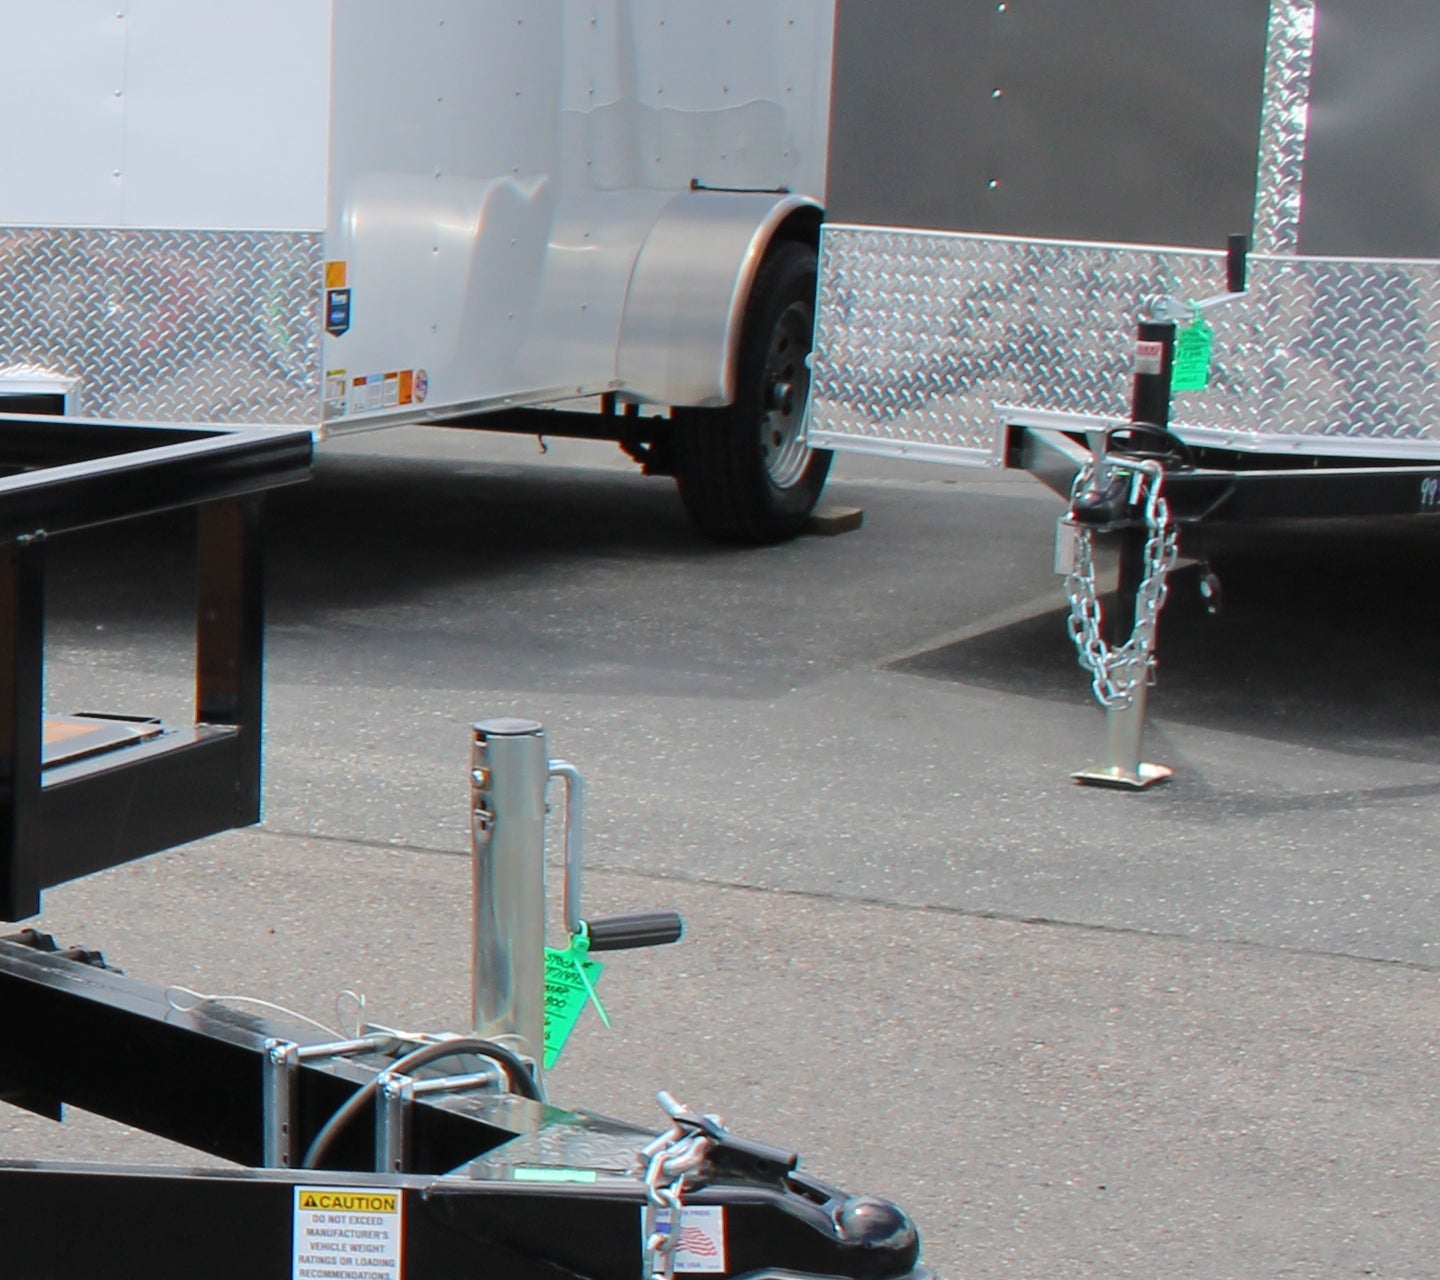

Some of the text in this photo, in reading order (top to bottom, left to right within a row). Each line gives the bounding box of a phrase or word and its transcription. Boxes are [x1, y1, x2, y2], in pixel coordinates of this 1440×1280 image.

[319, 1195, 396, 1211] CAUTION
[312, 1214, 383, 1225] DO NOT EXCEED
[306, 1228, 389, 1239] MANUFACTURER'S
[309, 1242, 385, 1253] VEHICLE WEIGHT
[298, 1255, 396, 1267] RATINGS OR LOADING
[299, 1269, 394, 1280] RECOMMENDATIONS.
